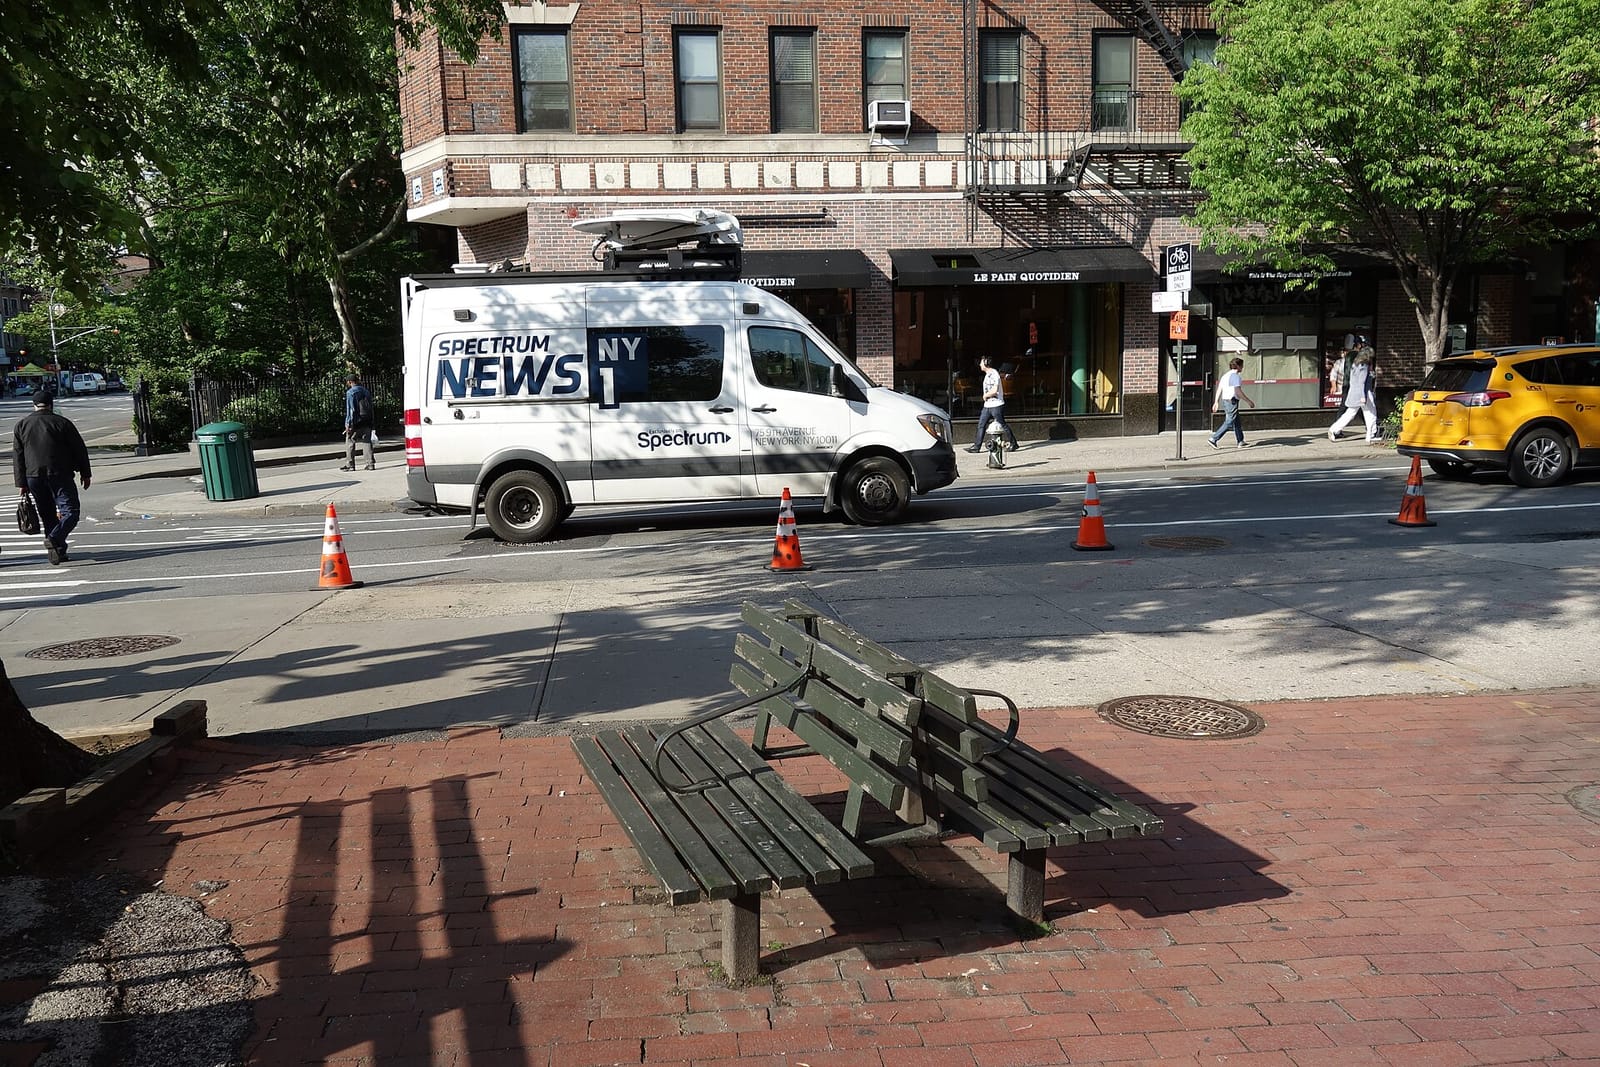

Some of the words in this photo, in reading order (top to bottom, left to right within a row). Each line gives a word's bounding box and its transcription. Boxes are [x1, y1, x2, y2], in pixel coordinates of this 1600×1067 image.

[738, 278, 795, 287] UOTIDIEN
[973, 273, 988, 281] LE
[991, 273, 1017, 281] PAIN
[1020, 272, 1079, 281] QUOTIDIEN
[438, 335, 550, 356] SPECTRUM
[599, 337, 642, 361] NY
[434, 353, 584, 400] NEWS
[599, 367, 615, 405] 1
[637, 430, 725, 452] Spectrum
[755, 428, 764, 437] 75
[766, 428, 781, 437] 9TH
[782, 427, 816, 437] AVENUE
[755, 437, 775, 446] NEW
[803, 436, 815, 445] NY
[816, 435, 838, 444] 10011
